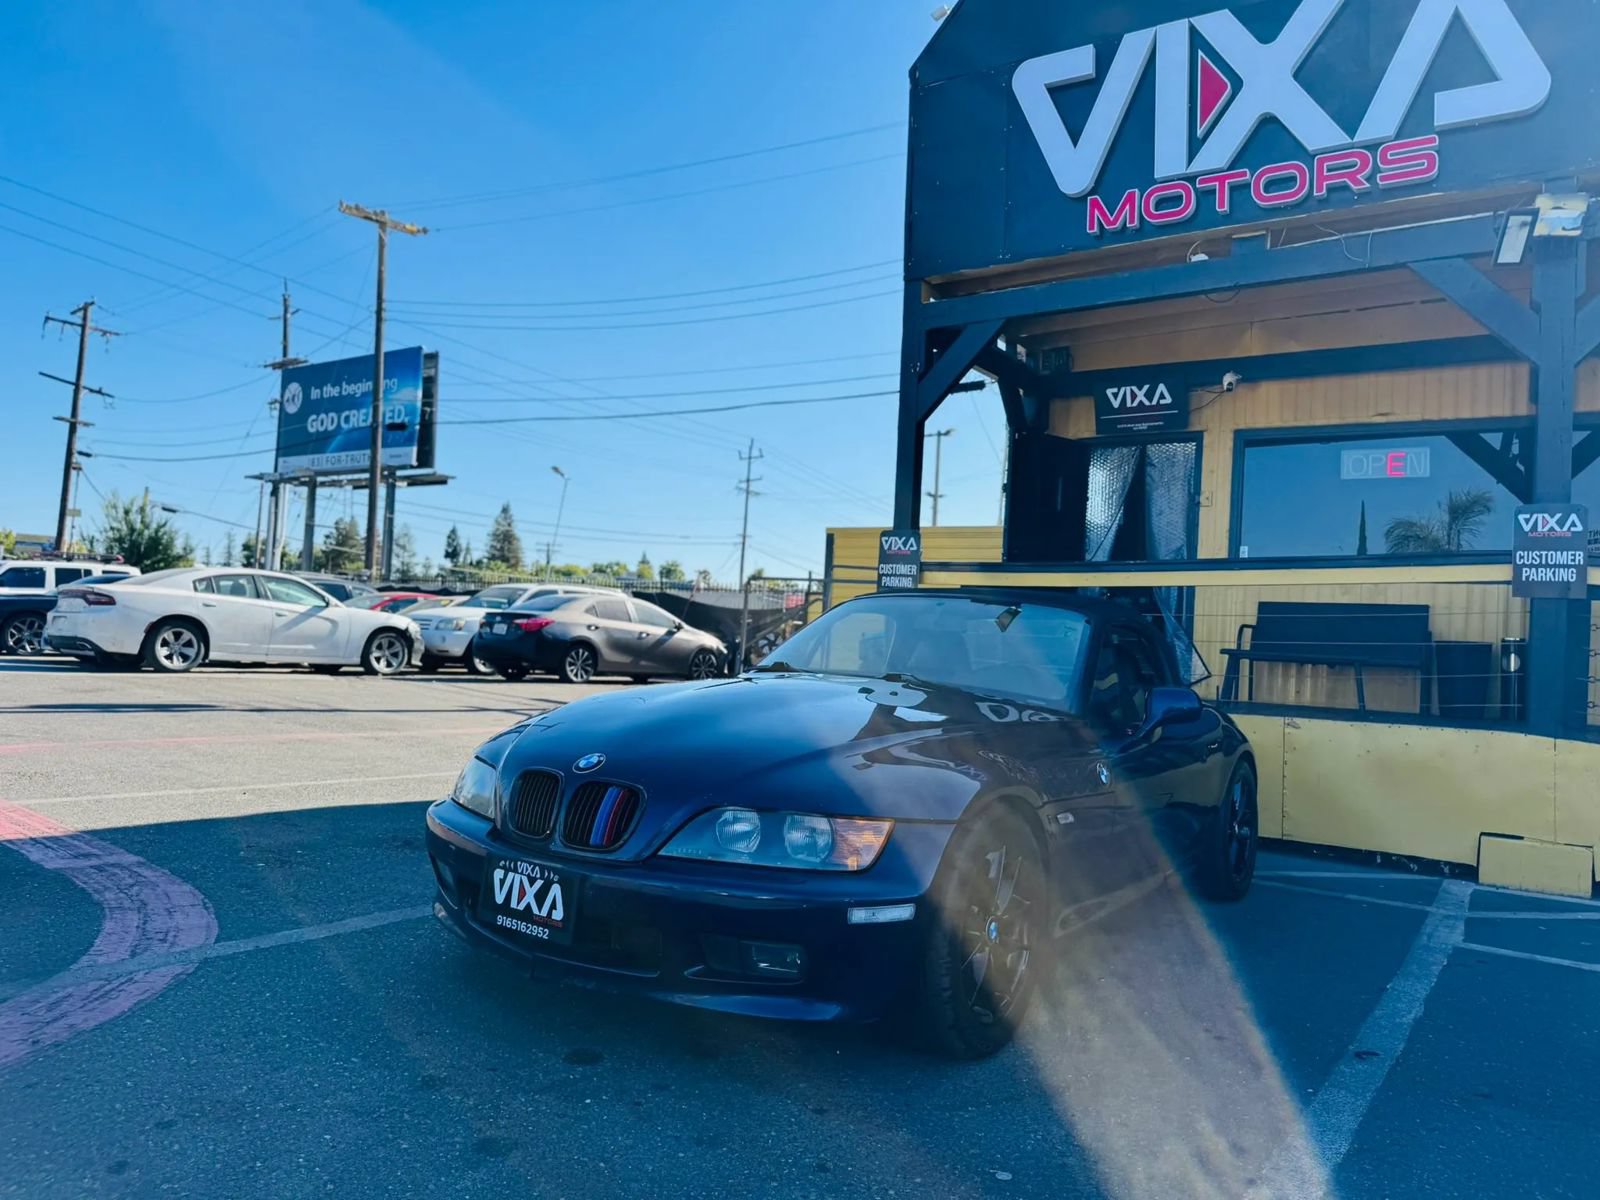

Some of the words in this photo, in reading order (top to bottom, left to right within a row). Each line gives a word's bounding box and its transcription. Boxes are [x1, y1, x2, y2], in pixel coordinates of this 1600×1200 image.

[1012, 0, 1552, 198] VIXA
[1087, 134, 1439, 234] MOTORS
[311, 386, 320, 400] In
[323, 383, 340, 398] the
[342, 378, 398, 398] beginng
[1106, 383, 1172, 408] VIXA
[307, 412, 338, 433] GOD
[1349, 451, 1425, 477] OPEN
[1517, 512, 1584, 532] VIXA
[881, 536, 917, 550] VIXA
[1516, 550, 1584, 565] CUSTOMER
[879, 564, 917, 575] CUSTOMER
[1522, 567, 1577, 582] PARKING
[881, 576, 913, 588] PARKING
[517, 861, 541, 878] VIXA
[494, 868, 564, 920] VIXA
[497, 915, 549, 939] 9165162952
